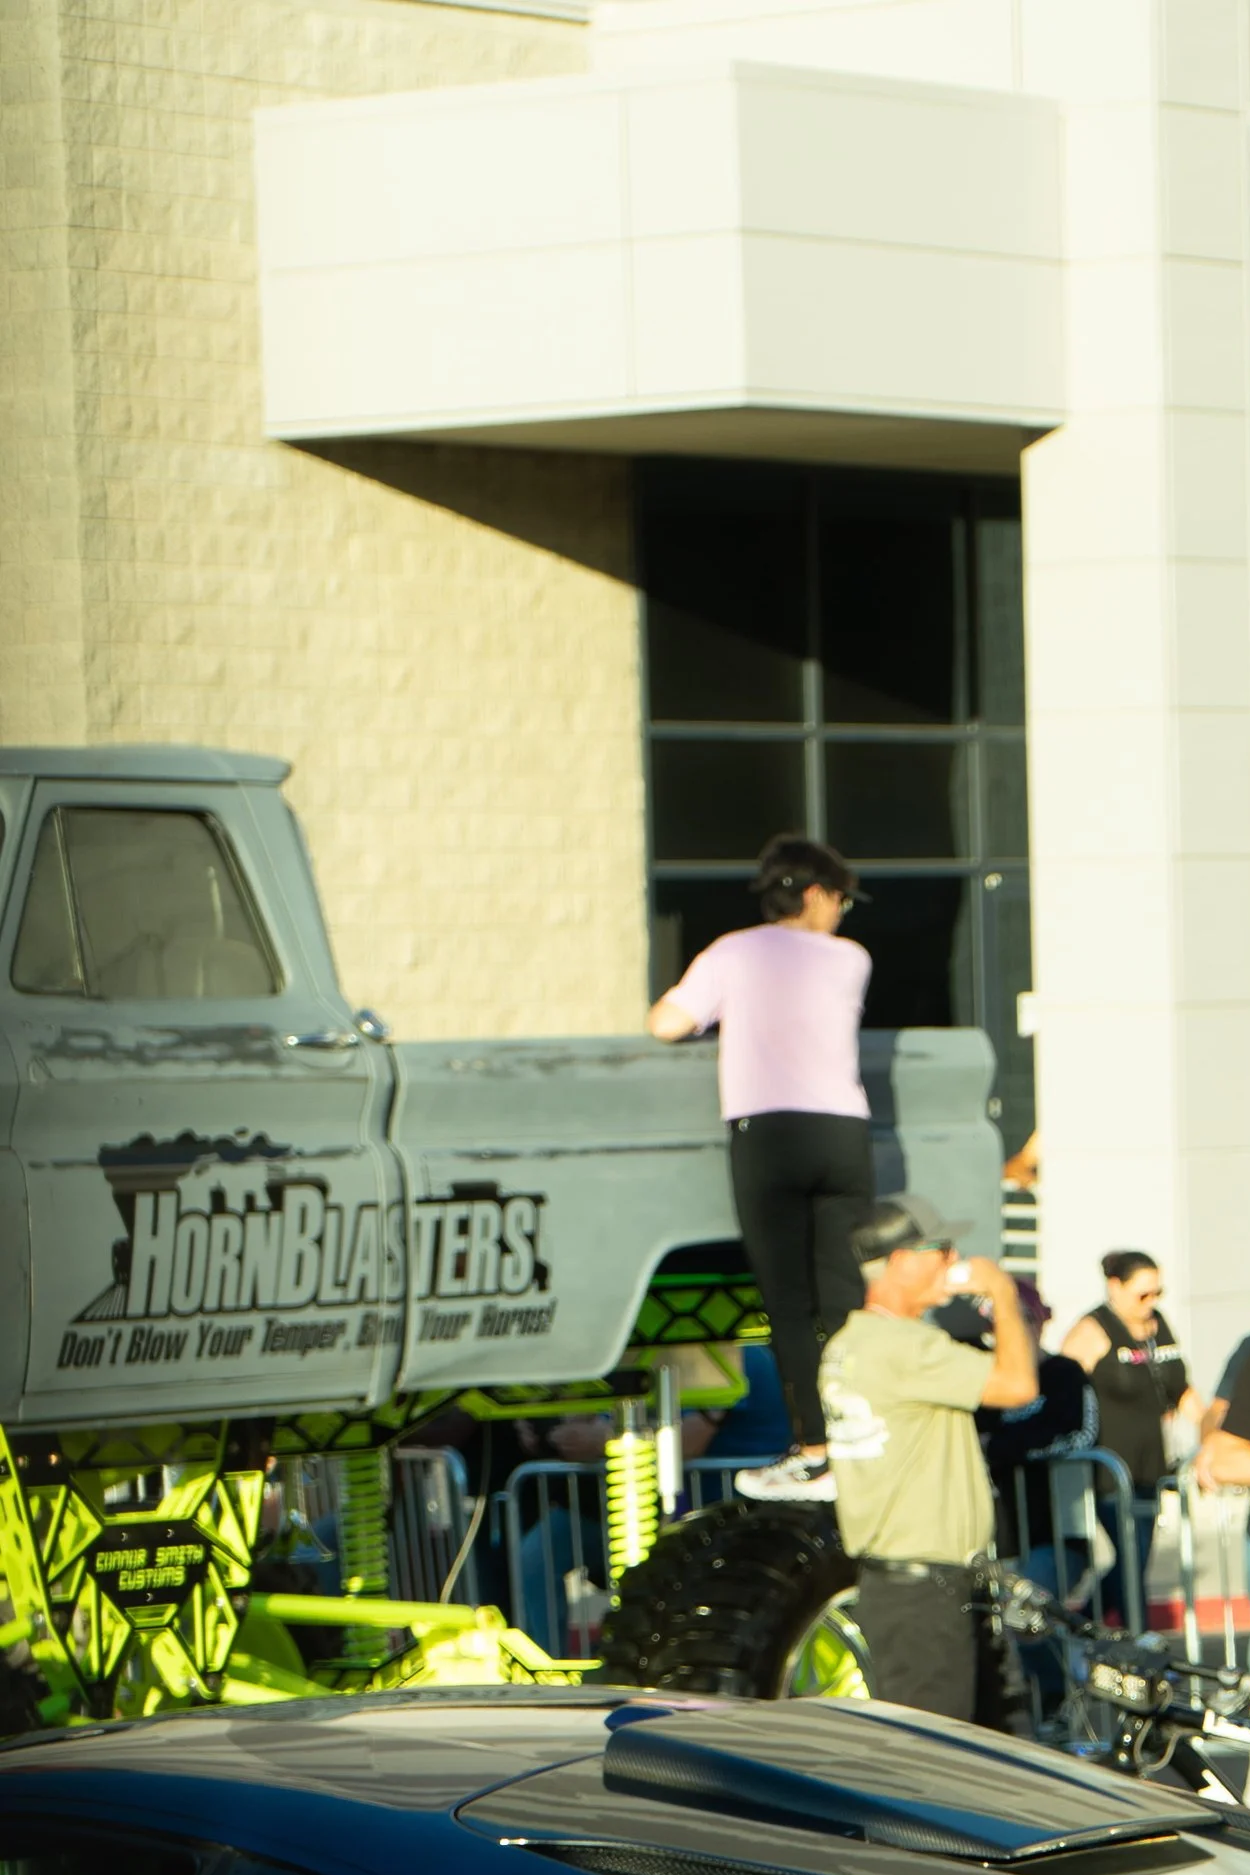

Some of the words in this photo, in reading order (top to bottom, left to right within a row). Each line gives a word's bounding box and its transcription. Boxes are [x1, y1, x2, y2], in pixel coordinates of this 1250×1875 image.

[56, 1326, 122, 1369] Don't
[124, 1323, 189, 1365] Blow
[195, 1319, 254, 1359] Your
